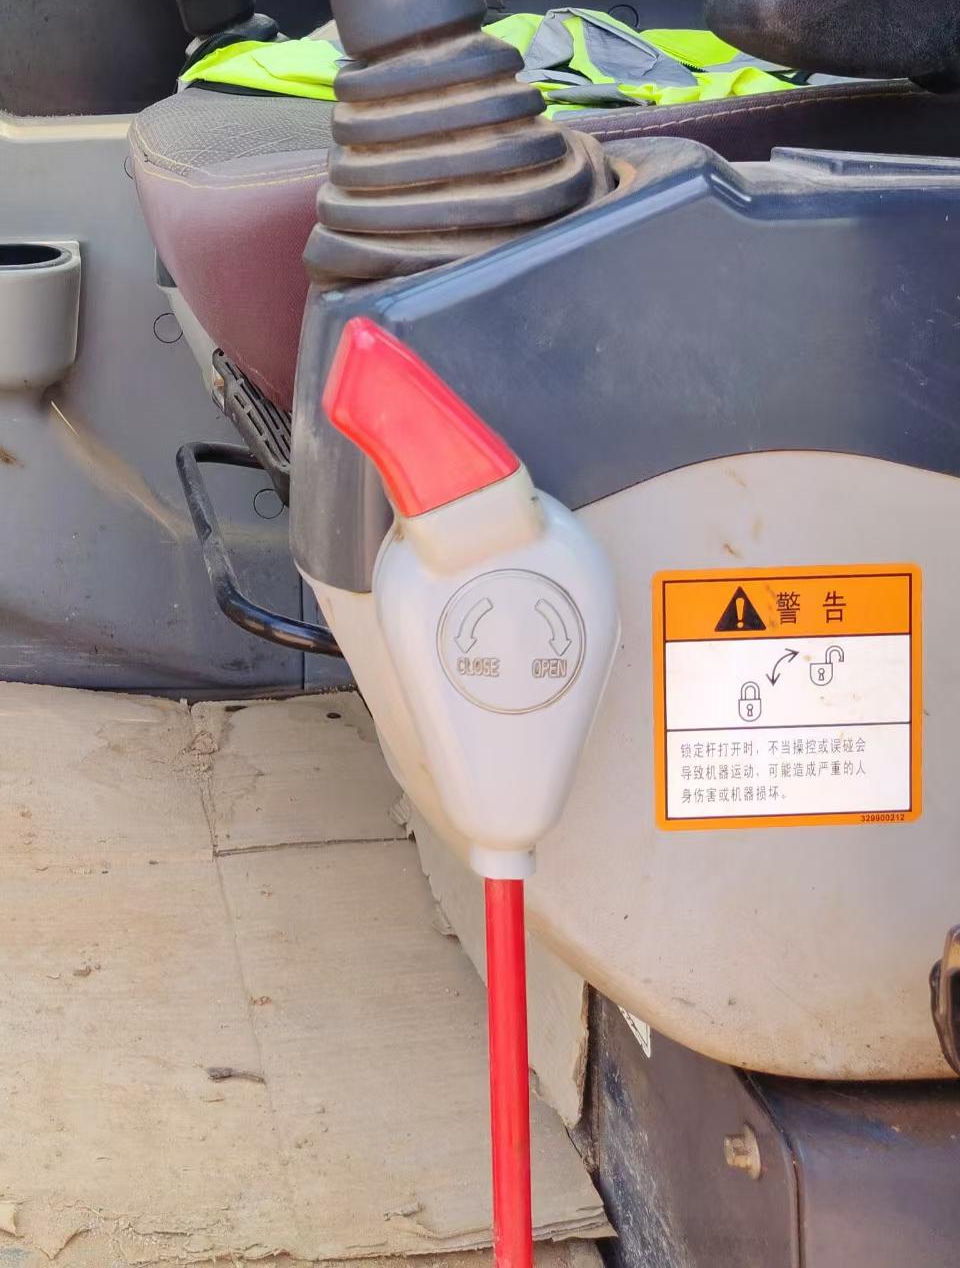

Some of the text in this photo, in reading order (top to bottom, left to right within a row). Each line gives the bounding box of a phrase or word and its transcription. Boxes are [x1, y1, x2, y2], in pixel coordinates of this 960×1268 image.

[776, 590, 847, 625] 警告
[457, 657, 500, 677] CLOSE
[531, 658, 568, 679] OPEN
